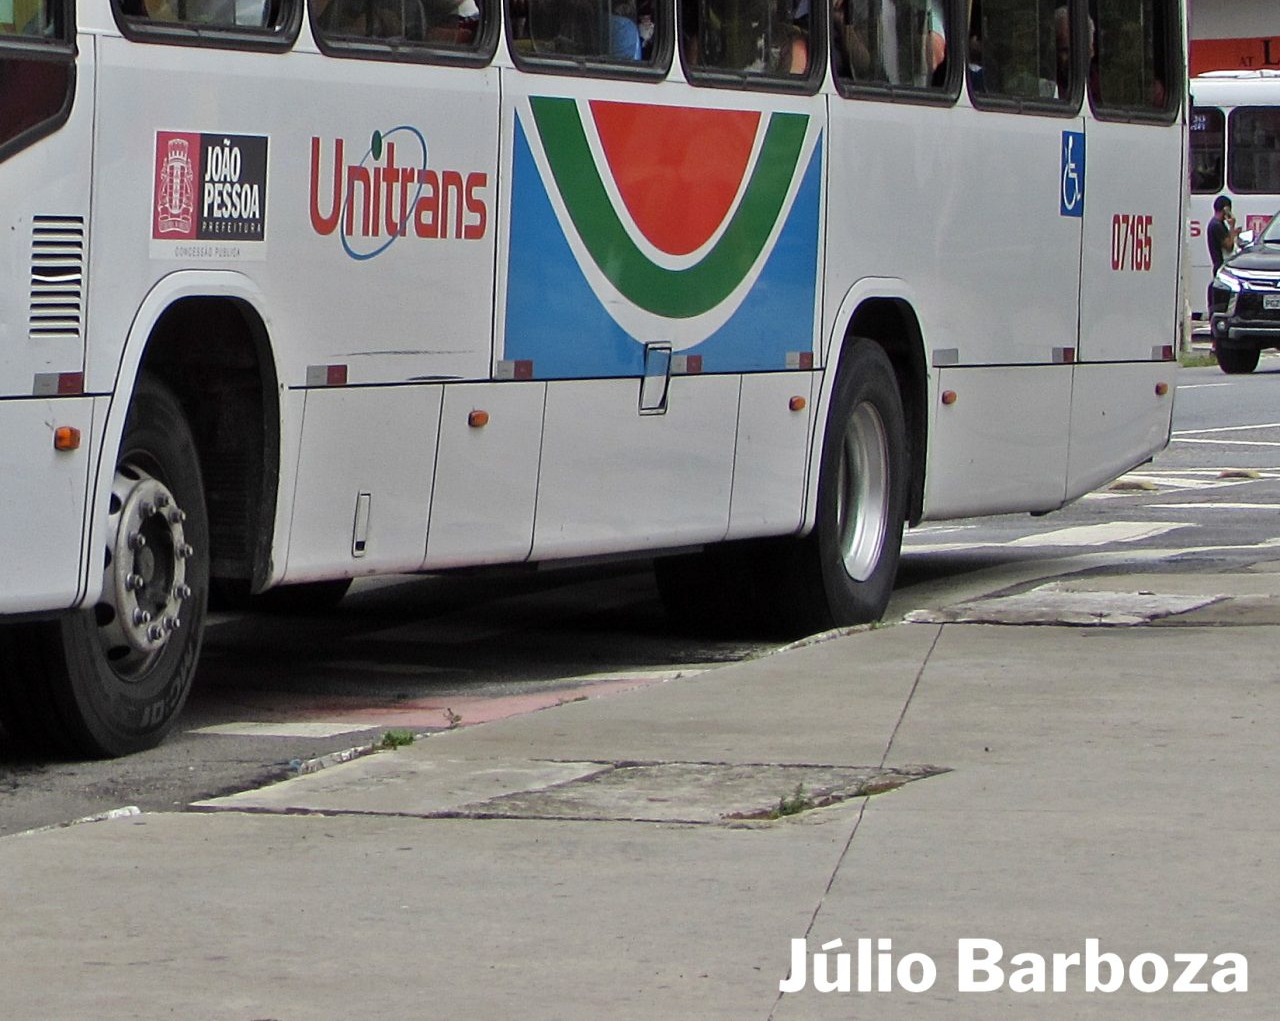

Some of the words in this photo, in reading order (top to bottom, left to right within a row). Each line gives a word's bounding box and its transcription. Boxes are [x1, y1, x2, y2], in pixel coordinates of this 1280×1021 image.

[204, 138, 242, 183] JOÃO
[203, 182, 261, 219] PESSOA
[308, 130, 489, 240] Unitrans
[201, 221, 262, 234] PREFEITURA
[1111, 213, 1153, 272] 07165
